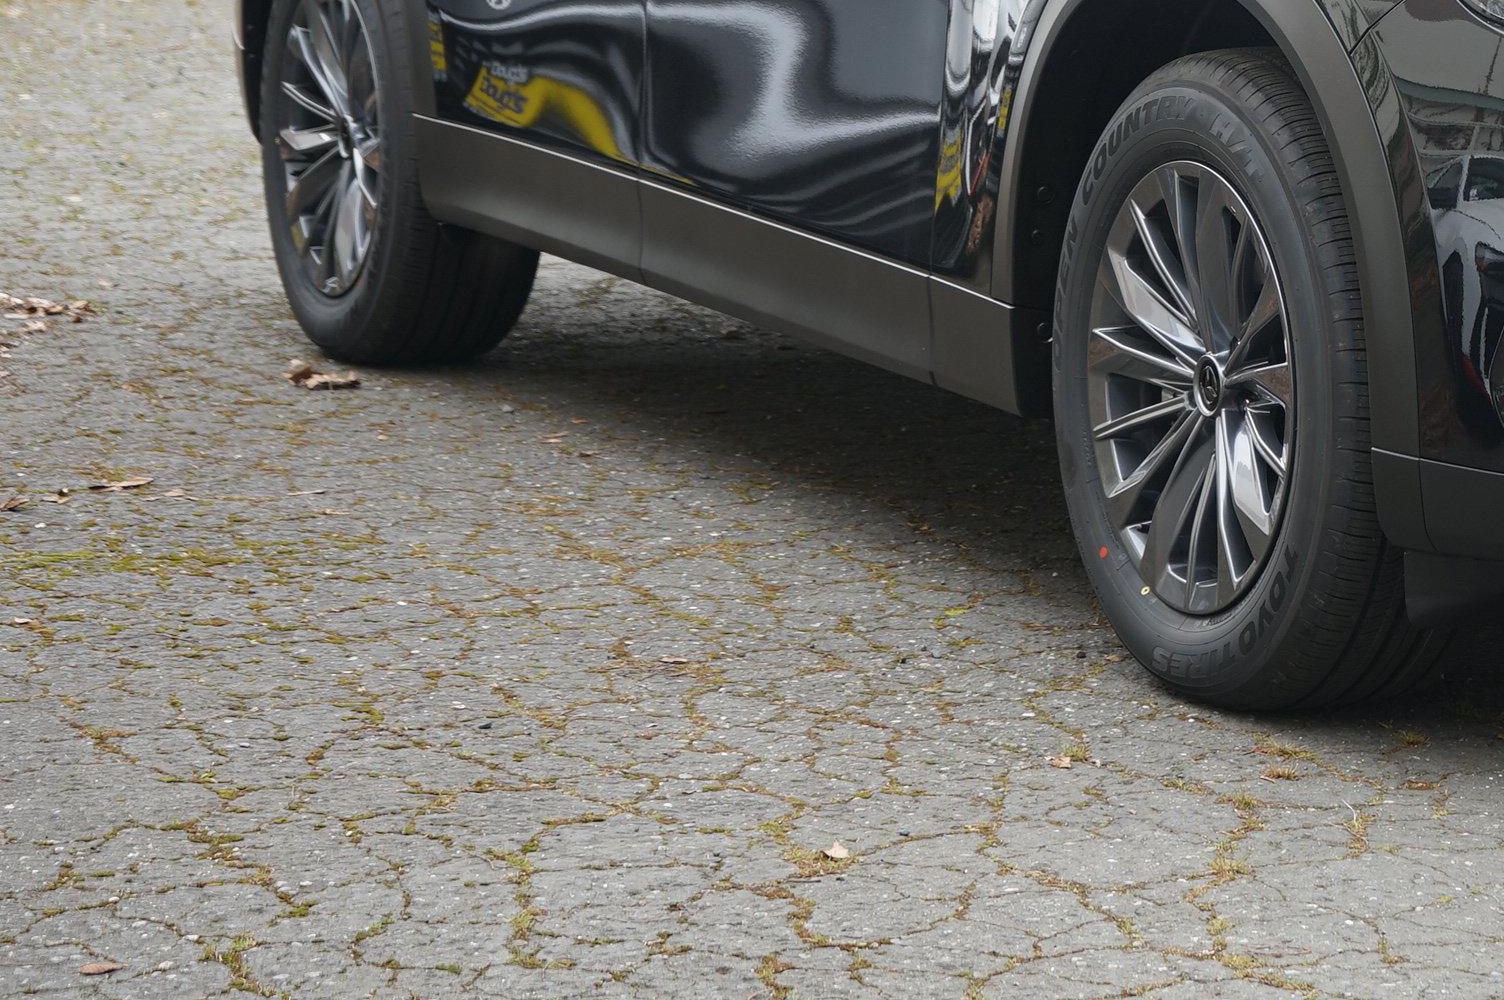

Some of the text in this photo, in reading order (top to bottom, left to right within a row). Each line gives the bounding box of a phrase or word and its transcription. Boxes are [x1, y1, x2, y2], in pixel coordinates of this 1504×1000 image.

[1053, 214, 1079, 373] OPEN
[1081, 95, 1194, 206] COUNTRY
[1151, 543, 1299, 679] TOYO TIRES
